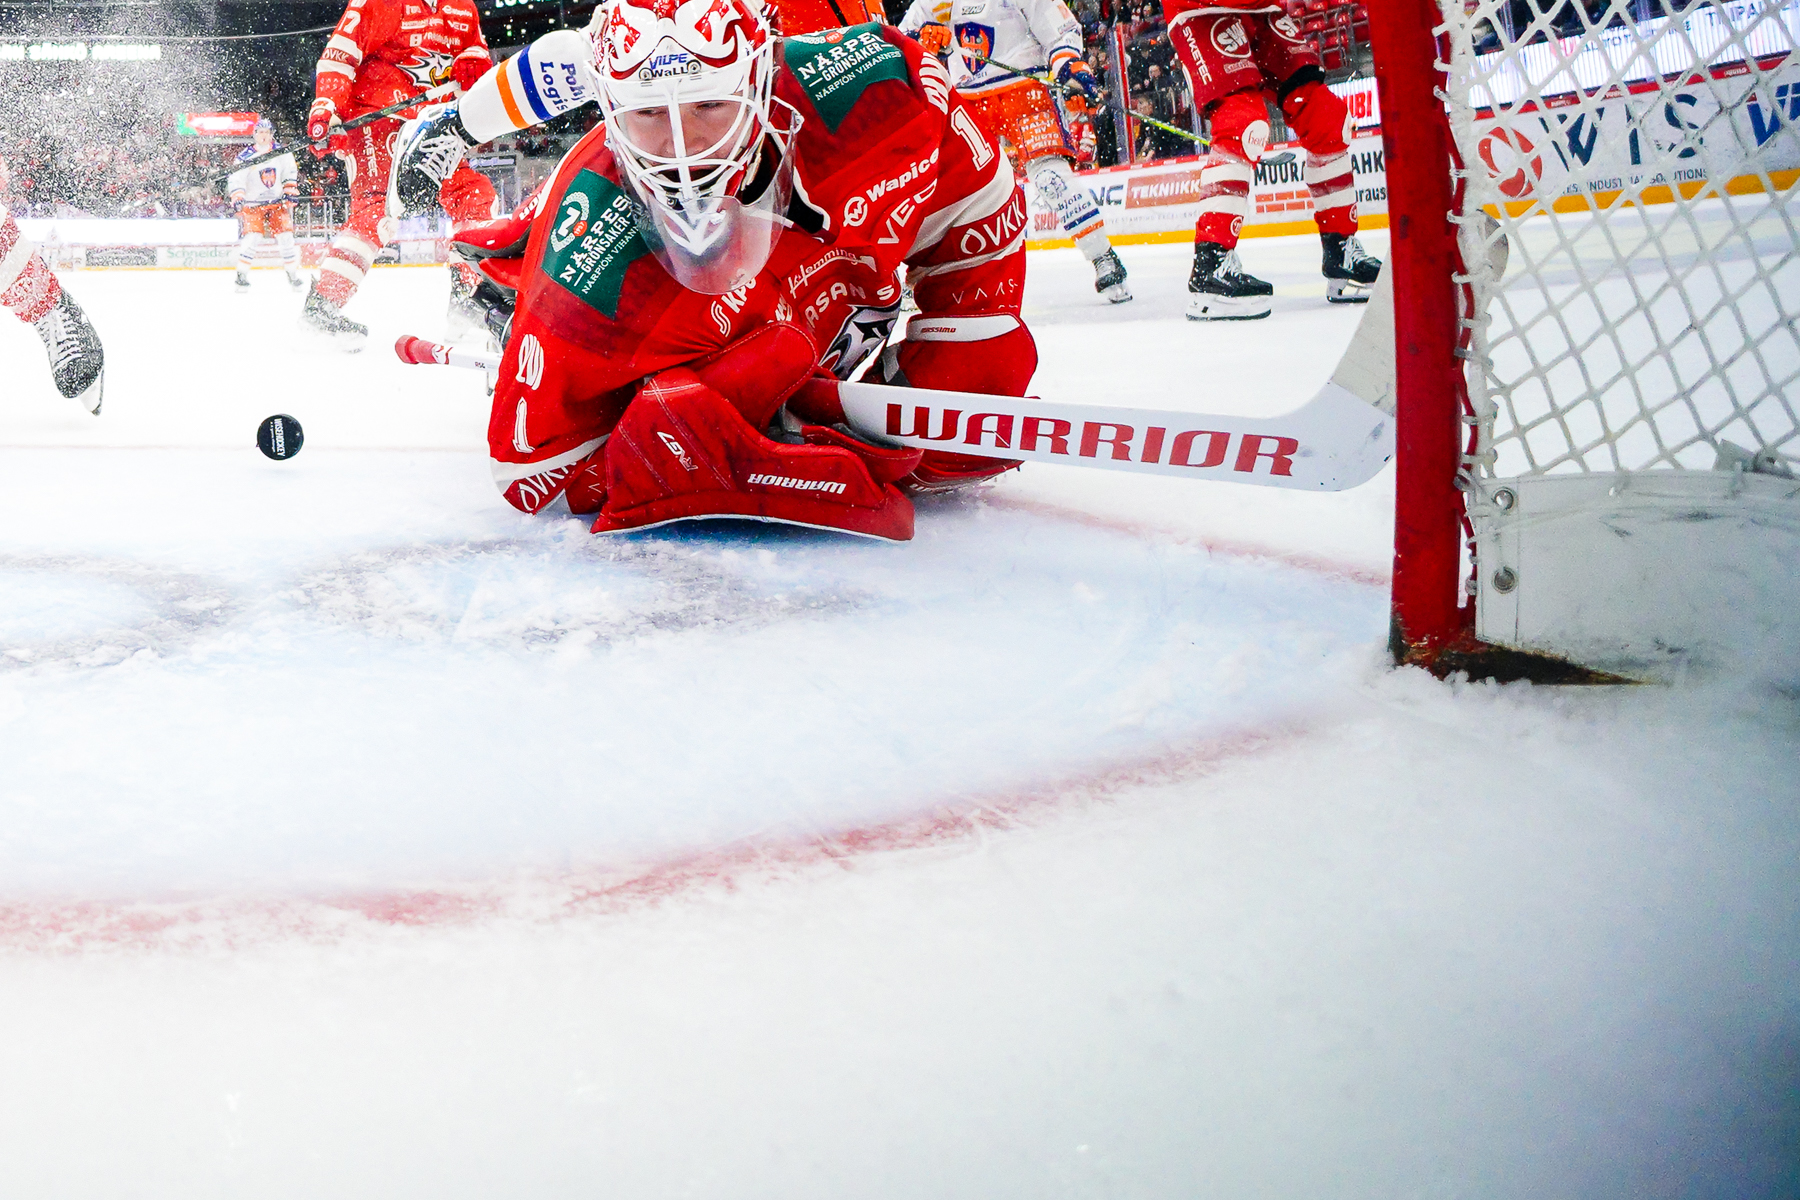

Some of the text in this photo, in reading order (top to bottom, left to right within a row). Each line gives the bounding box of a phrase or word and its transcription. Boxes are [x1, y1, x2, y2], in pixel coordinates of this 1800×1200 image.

[649, 53, 689, 70] VILPE
[826, 31, 841, 44] 1957
[1182, 20, 1249, 86] SYKETEC SW
[814, 71, 857, 101] NÄRPIÖN
[821, 42, 883, 83] GRÖNSAKER
[362, 125, 379, 178] SYKETEC
[950, 104, 995, 172] 1
[865, 147, 940, 202] Wapice
[1131, 179, 1201, 200] TEKNIIKK
[559, 194, 633, 284] NÄRPES
[581, 216, 631, 275] GRÖNSAKER
[960, 193, 1027, 255] OVKK
[166, 248, 232, 260] Schneider
[581, 252, 614, 296] NÄRPIÖN
[804, 281, 867, 330] ASAN
[274, 418, 285, 457] WISEHOCKEY
[512, 396, 536, 454] 1
[885, 402, 1300, 478] WARRIOR
[747, 472, 847, 496] WARRIOR
